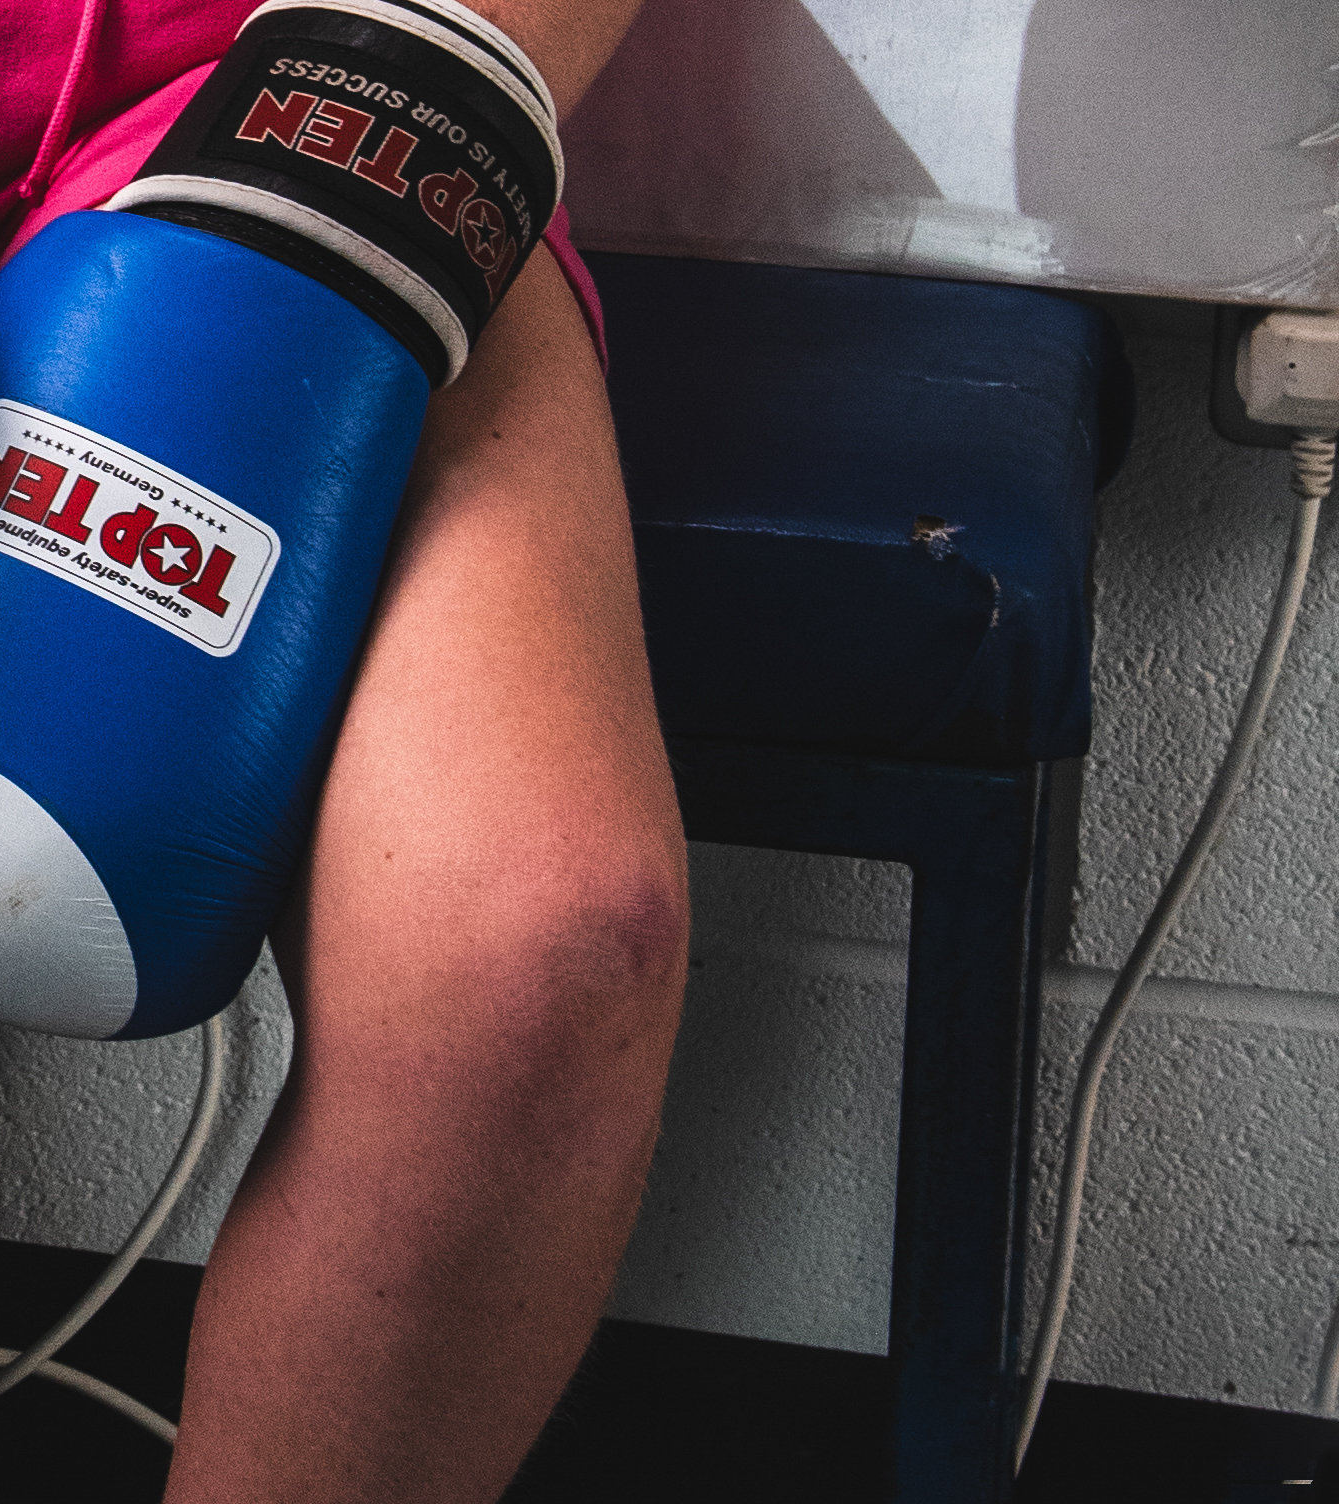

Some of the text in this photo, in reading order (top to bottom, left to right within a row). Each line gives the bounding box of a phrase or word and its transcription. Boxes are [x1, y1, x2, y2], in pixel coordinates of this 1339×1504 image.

[235, 87, 420, 199] TEN
[269, 58, 410, 110] SUCCESS
[411, 100, 467, 145] OUR
[468, 141, 497, 171] IS
[79, 450, 165, 502] Germany
[72, 549, 193, 620] super-safety
[99, 502, 237, 619] TOP
